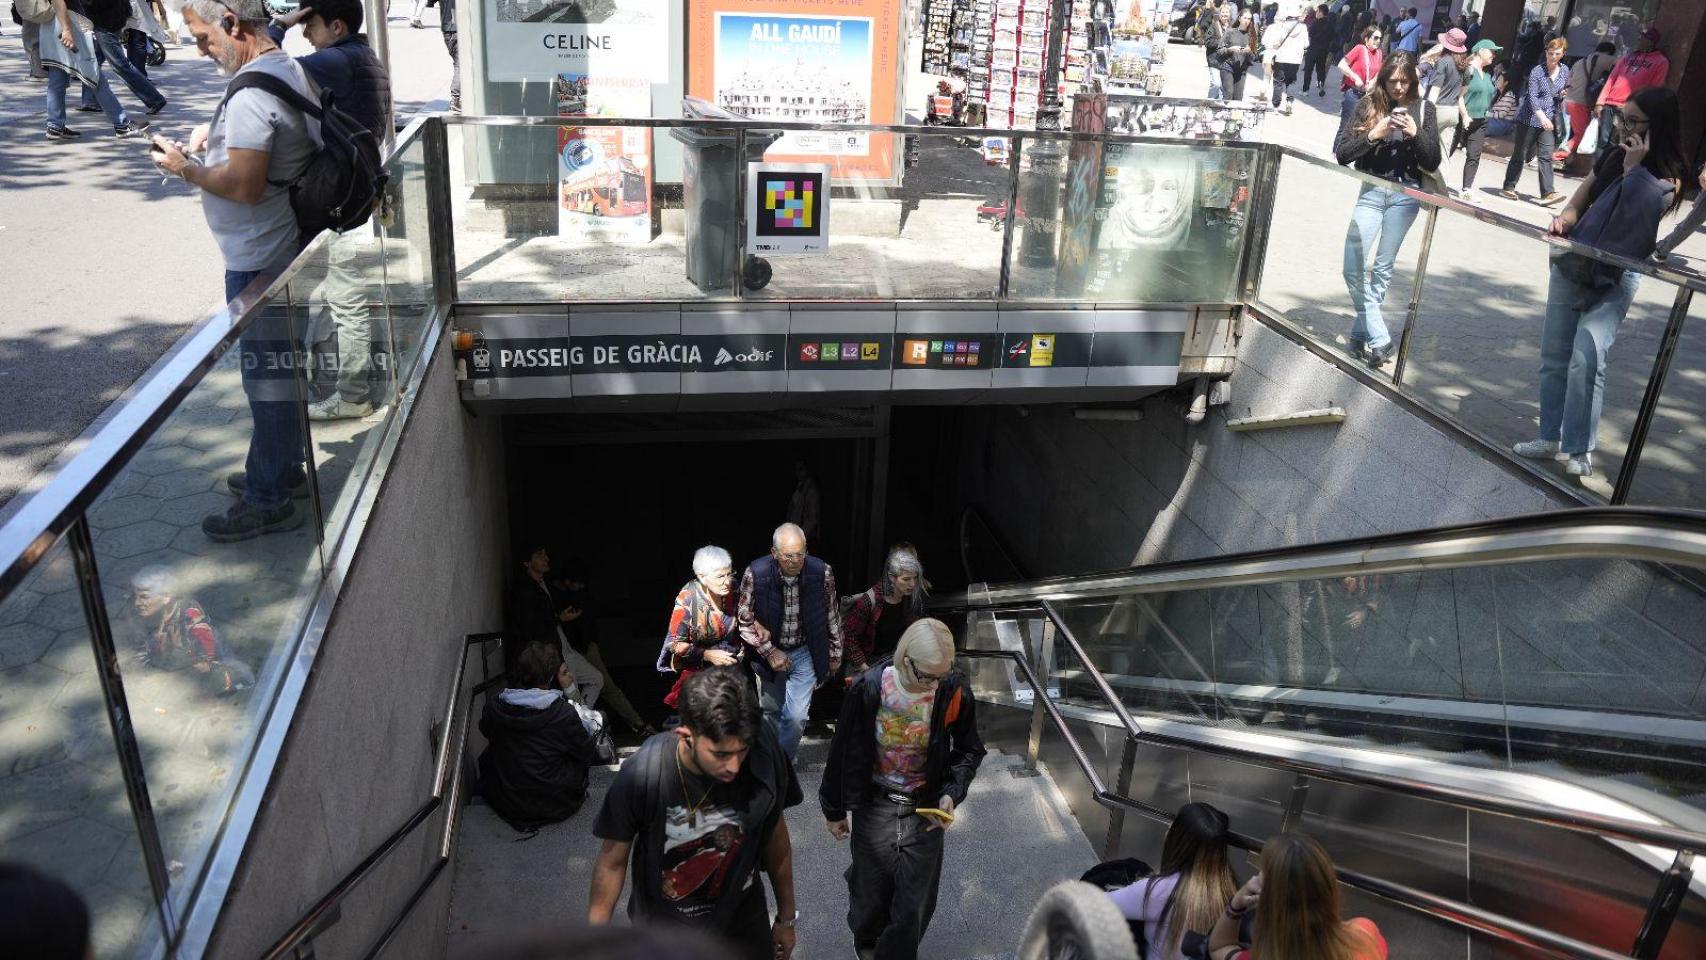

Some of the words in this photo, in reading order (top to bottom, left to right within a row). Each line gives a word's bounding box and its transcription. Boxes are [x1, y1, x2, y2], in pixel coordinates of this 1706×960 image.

[750, 22, 784, 43] ALL
[788, 21, 841, 44] GAUDÍ
[543, 34, 612, 50] CELINE
[500, 346, 584, 368] PASSEIG
[593, 345, 620, 365] DE
[627, 341, 702, 364] GRÀCIA
[823, 347, 838, 357] L3
[843, 347, 858, 357] L2
[863, 347, 877, 357] L4
[912, 343, 928, 361] R
[931, 341, 943, 353] R2
